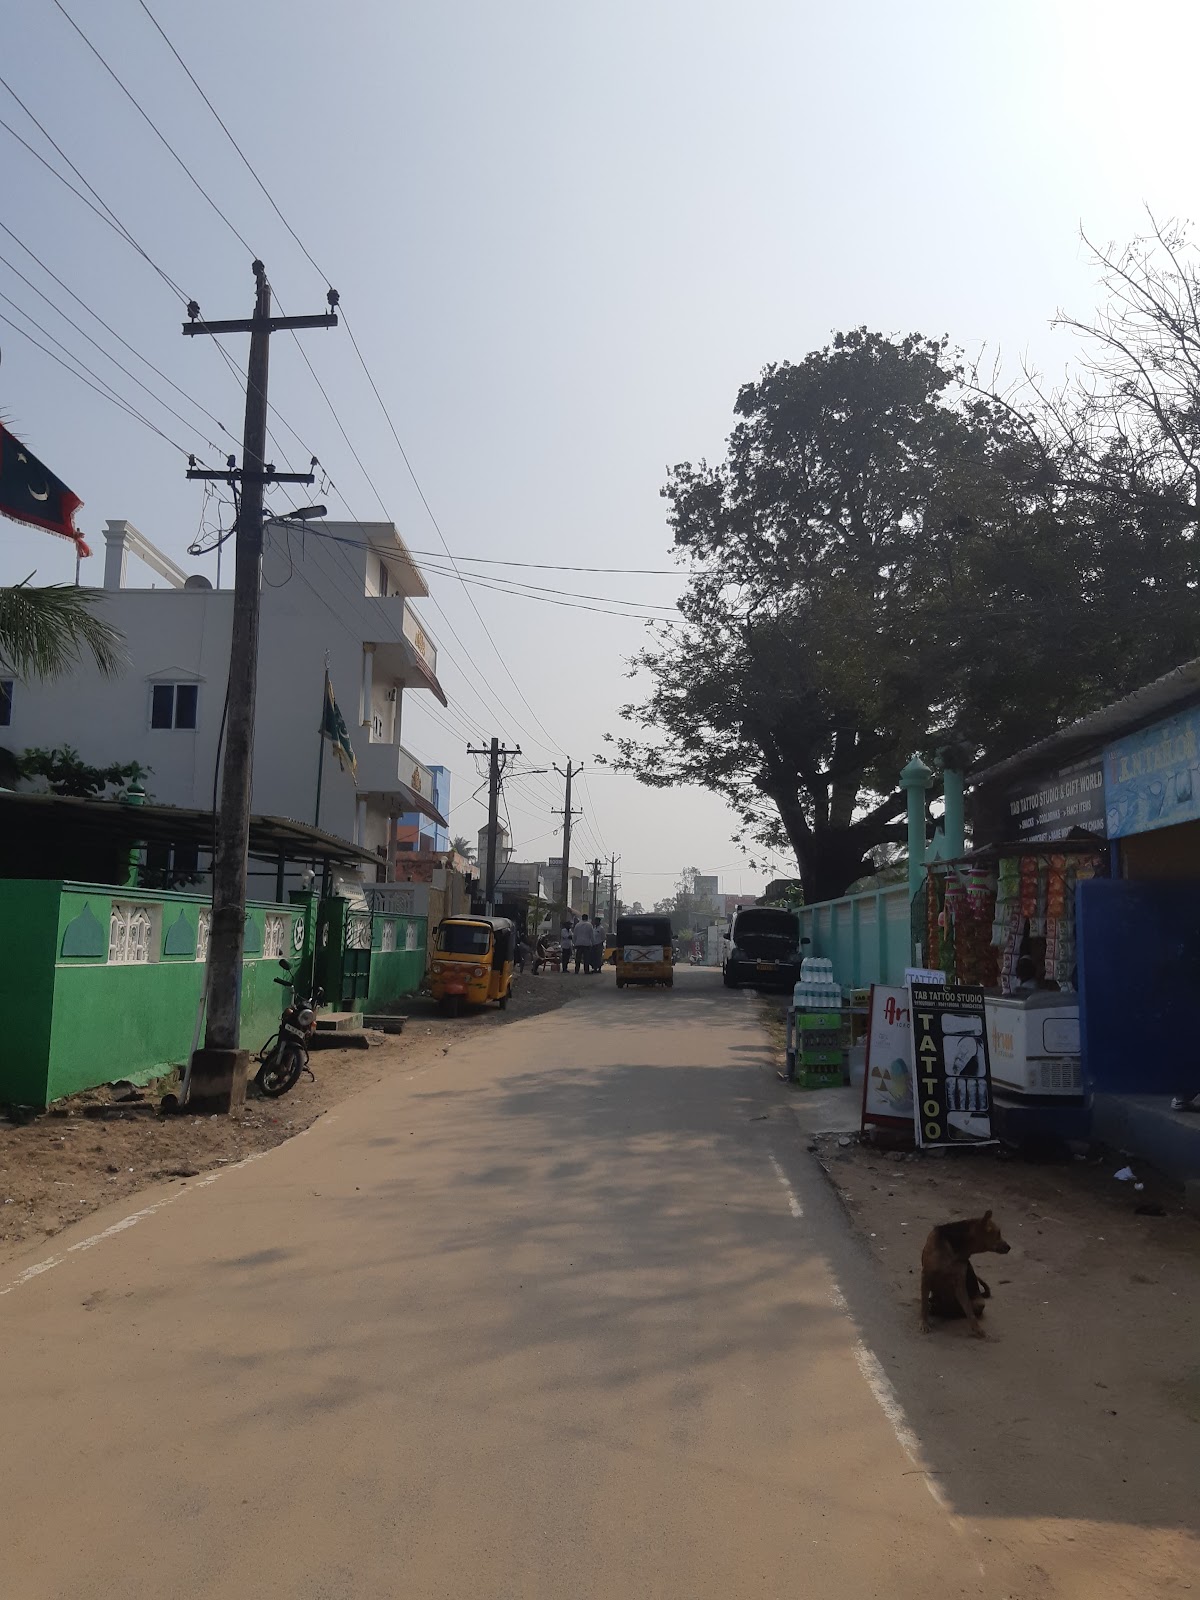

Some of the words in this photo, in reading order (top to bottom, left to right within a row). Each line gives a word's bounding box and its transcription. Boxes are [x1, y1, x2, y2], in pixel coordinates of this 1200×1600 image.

[1010, 801, 1020, 815] TAB
[1020, 793, 1039, 812] TATTOO
[1039, 787, 1059, 806] STUDIO
[1060, 784, 1065, 799] &
[1065, 779, 1079, 797] GIFT
[1079, 770, 1103, 793] WORLD
[1022, 817, 1034, 829] SNACKS
[1079, 800, 1092, 813] ITEMS
[914, 991, 928, 1000] TAB
[929, 992, 956, 1002] TATTOO
[956, 994, 982, 1003] STUDIO
[918, 1013, 941, 1139] TATTOO
